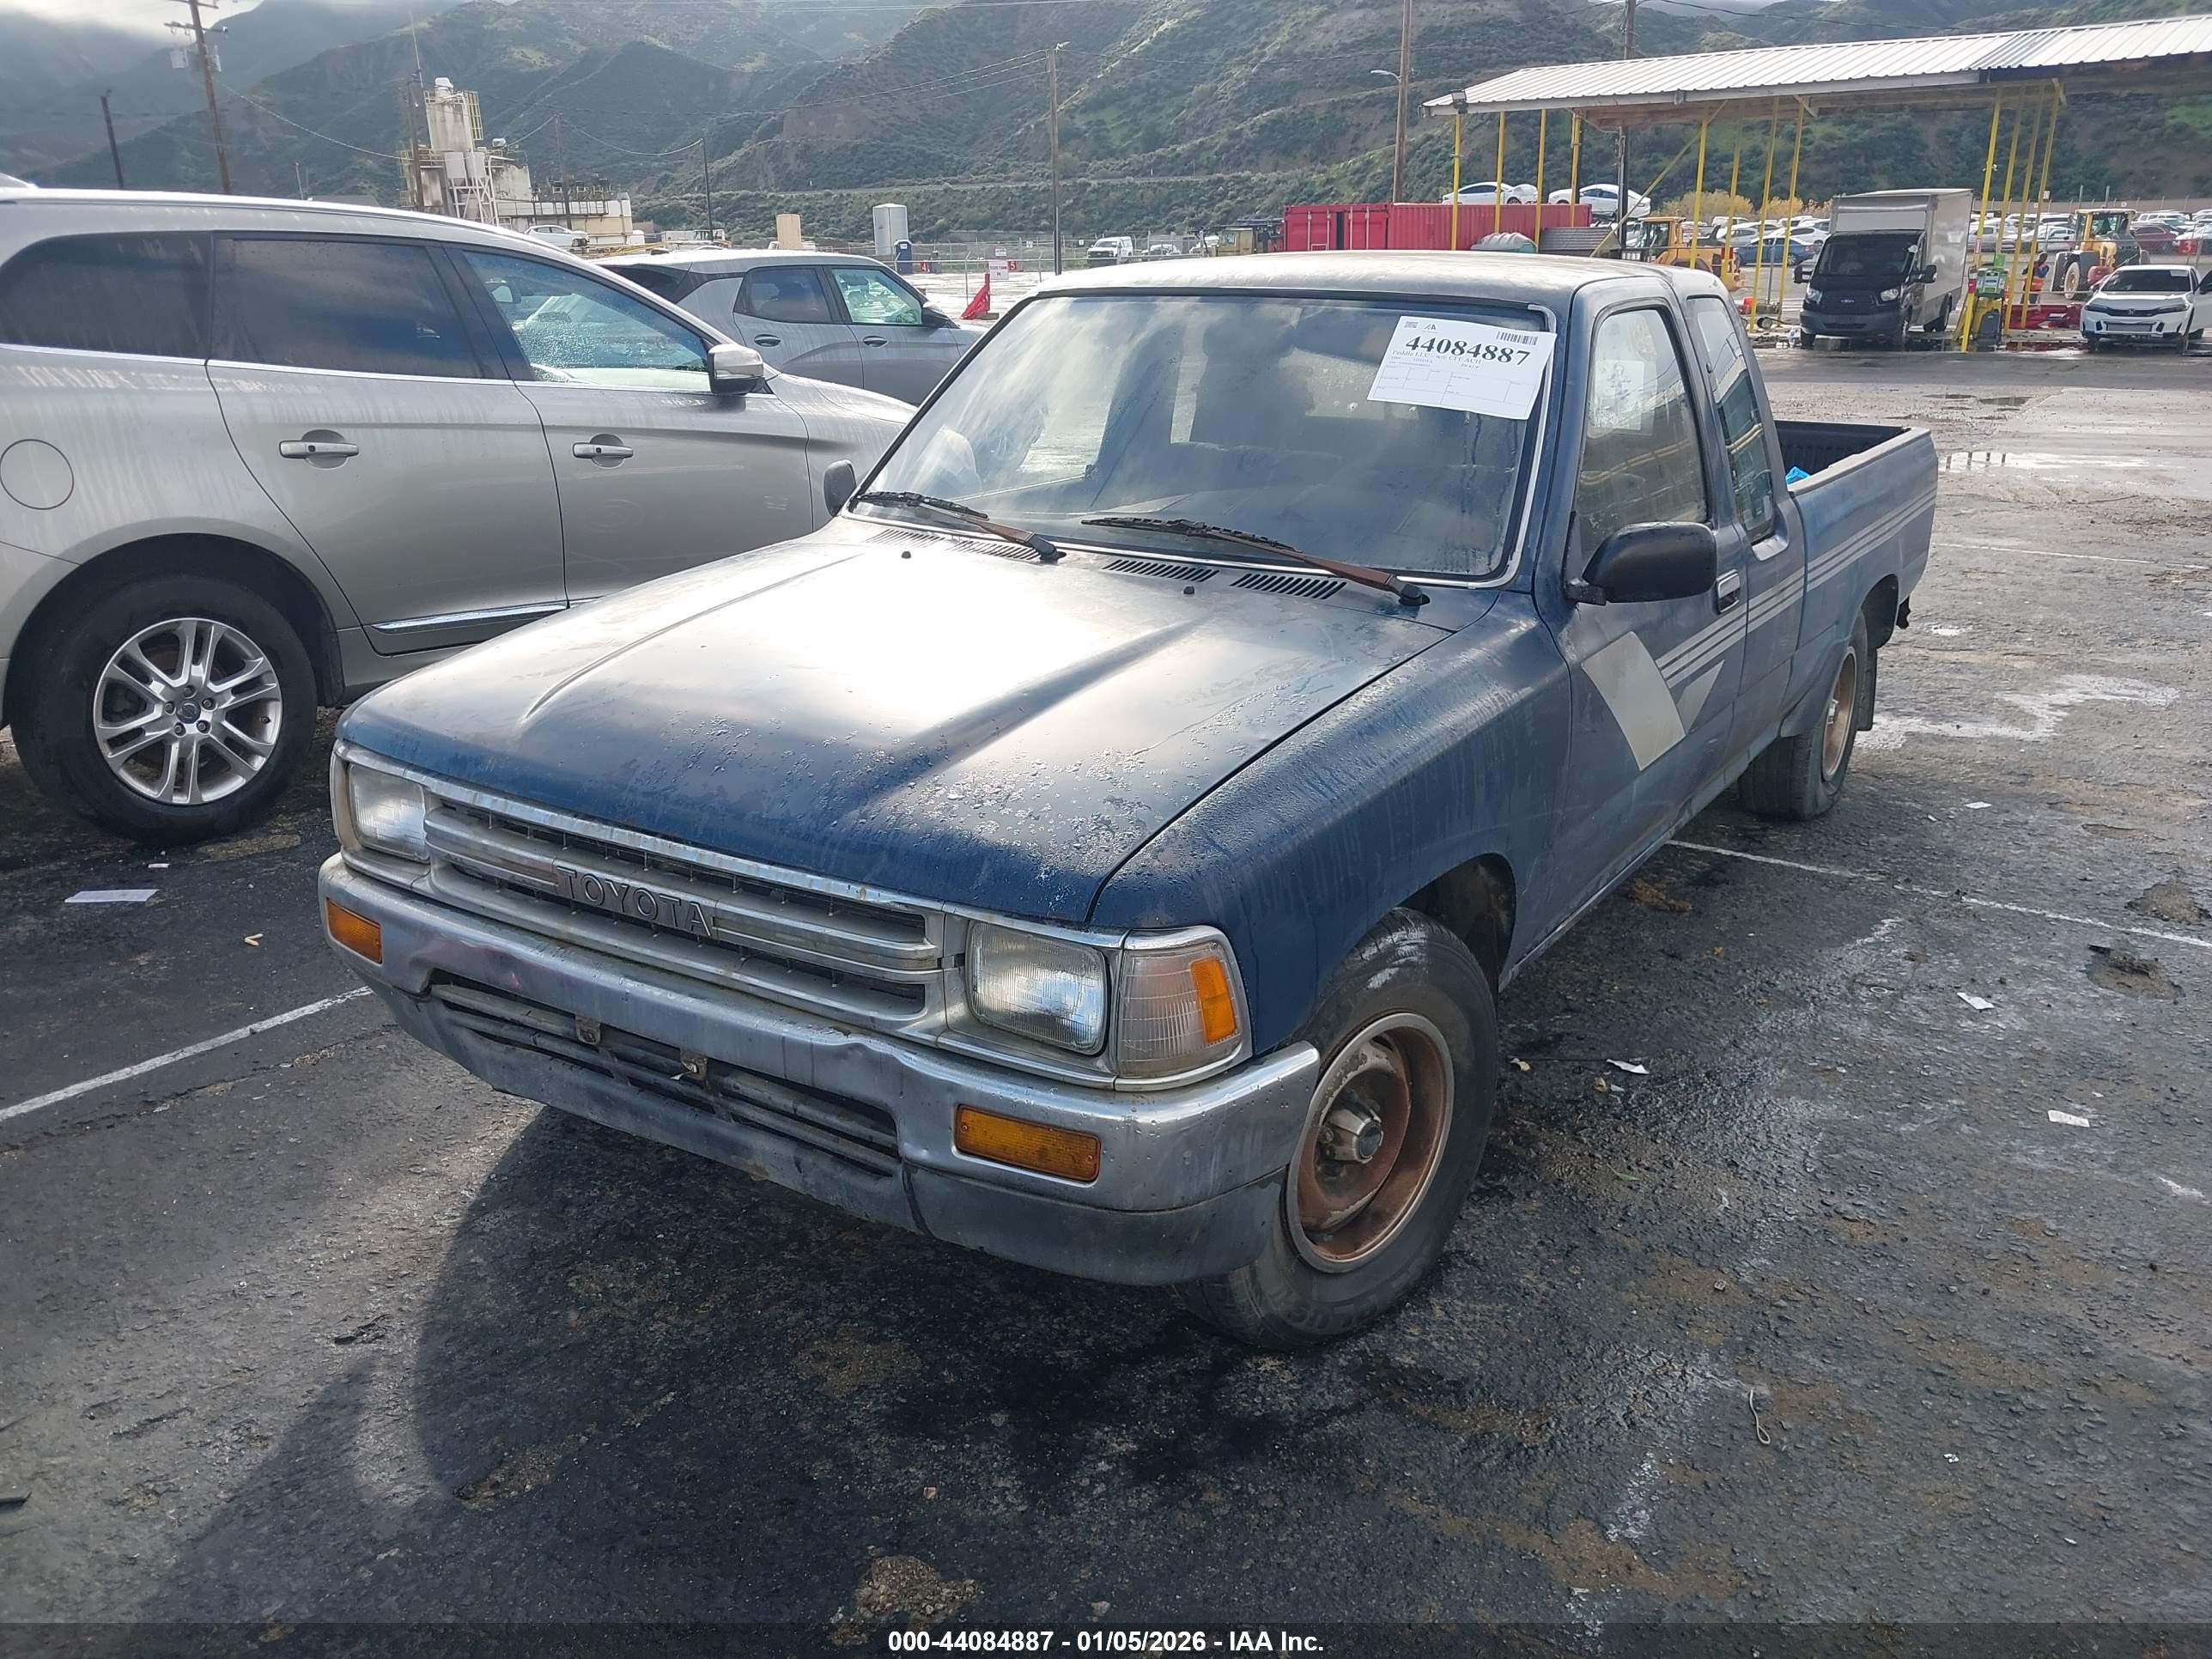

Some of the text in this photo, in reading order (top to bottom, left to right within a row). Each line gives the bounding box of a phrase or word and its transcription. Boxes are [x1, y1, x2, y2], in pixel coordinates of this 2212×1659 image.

[2182, 240, 2192, 253] 3
[1010, 261, 1016, 270] 5
[1405, 336, 1531, 365] 44084887
[556, 866, 712, 937] TOYOTA
